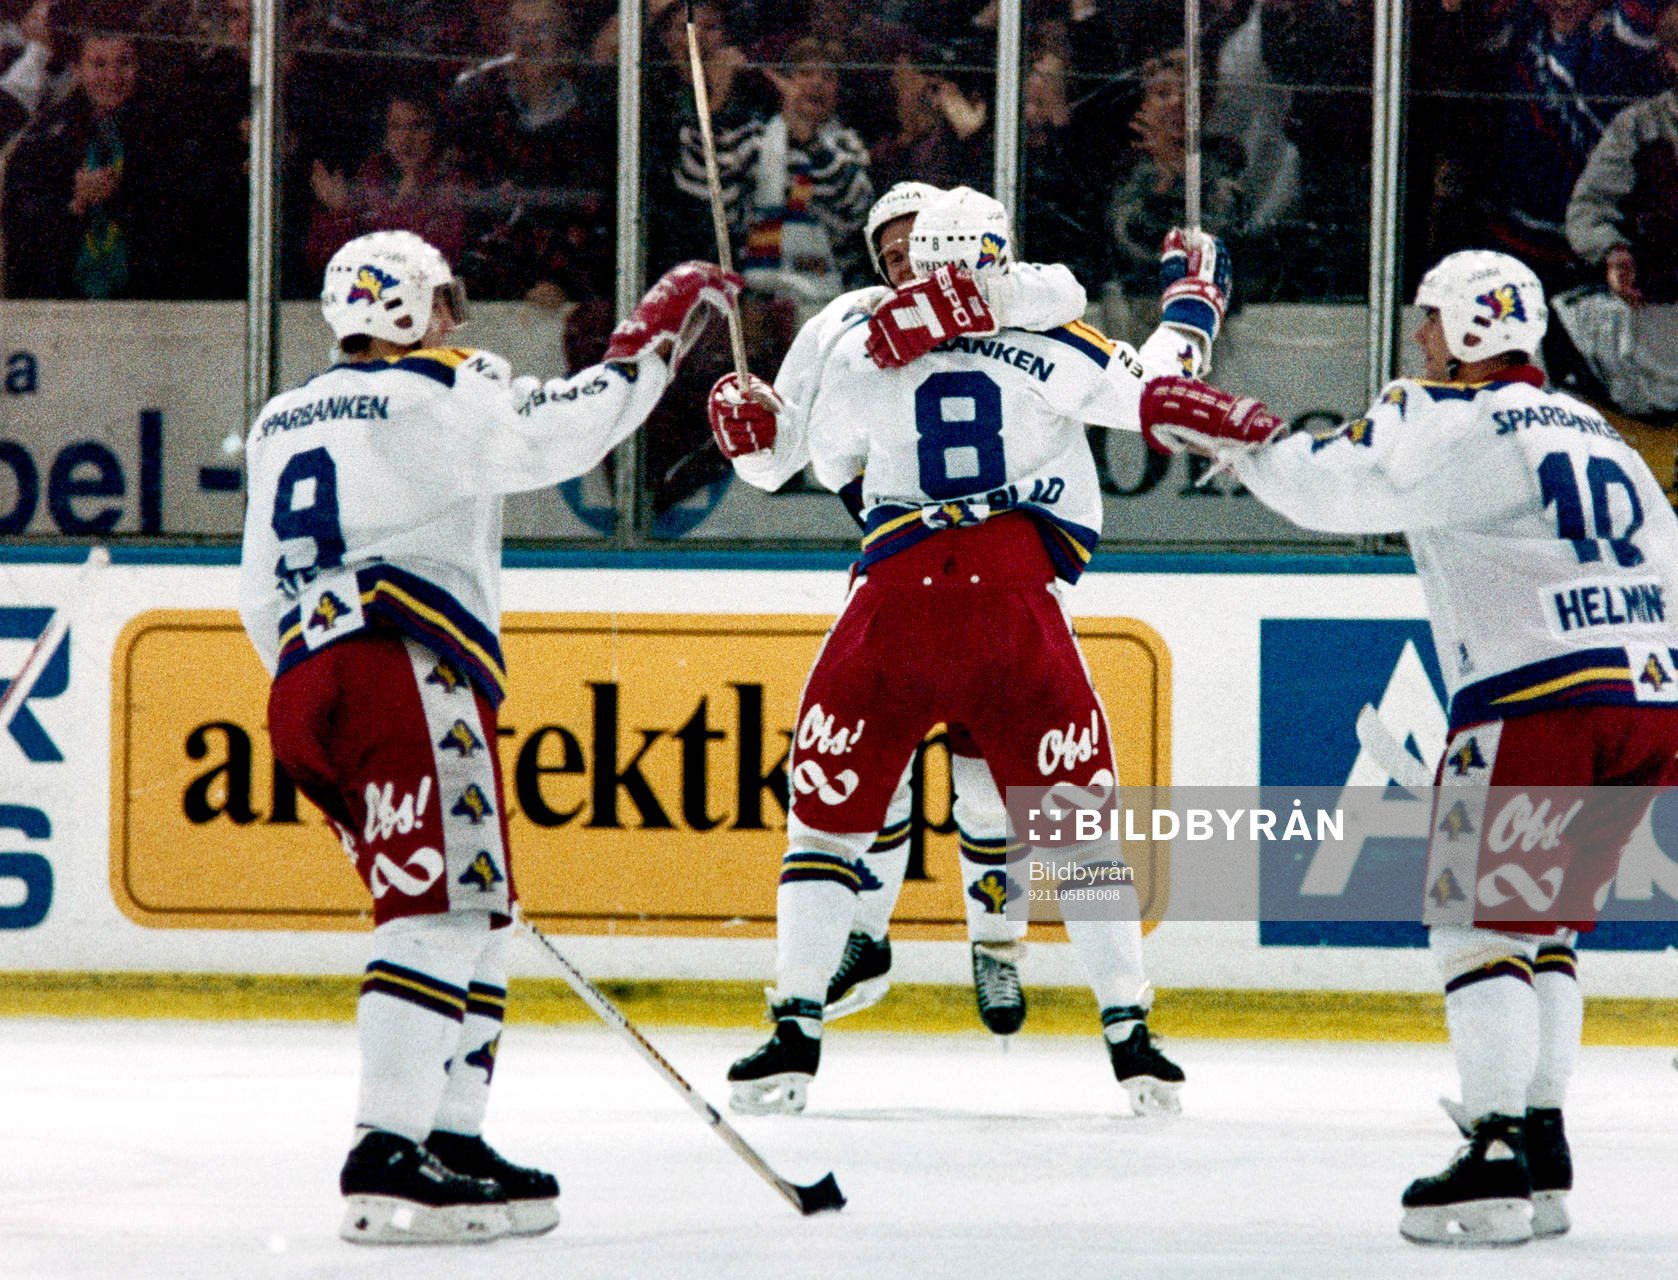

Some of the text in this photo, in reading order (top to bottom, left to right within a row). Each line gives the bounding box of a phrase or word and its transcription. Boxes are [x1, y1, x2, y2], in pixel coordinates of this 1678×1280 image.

[257, 395, 389, 441] PARBANKEN
[914, 370, 1007, 502] 8
[271, 446, 347, 570] 9
[1537, 452, 1646, 568] 10
